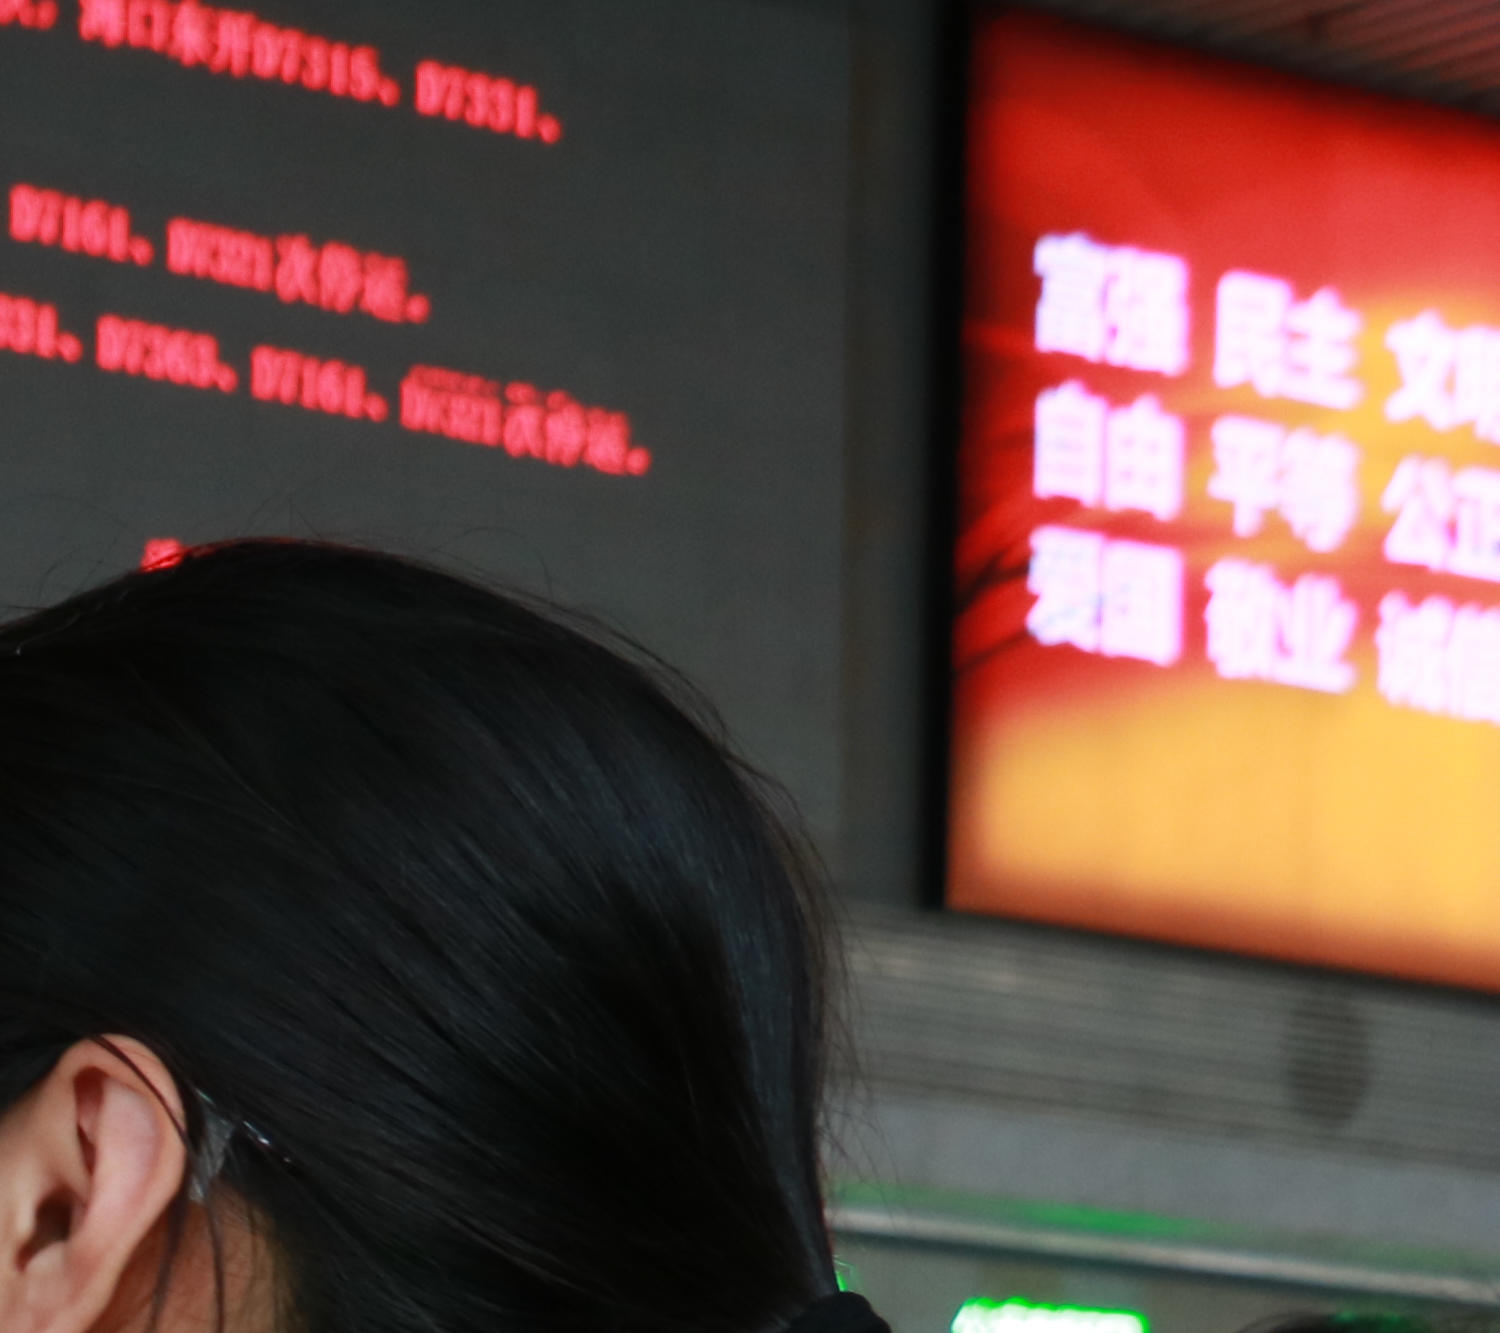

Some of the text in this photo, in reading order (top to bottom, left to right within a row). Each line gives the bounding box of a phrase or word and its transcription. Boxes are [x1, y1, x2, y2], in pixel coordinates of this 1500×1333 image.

[1035, 235, 1187, 376] 富强
[1213, 273, 1363, 411] 民主
[1035, 382, 1185, 521] 自由
[1207, 415, 1359, 553] 平等
[1028, 527, 1182, 666] 爱国
[1206, 557, 1356, 694] 敬业
